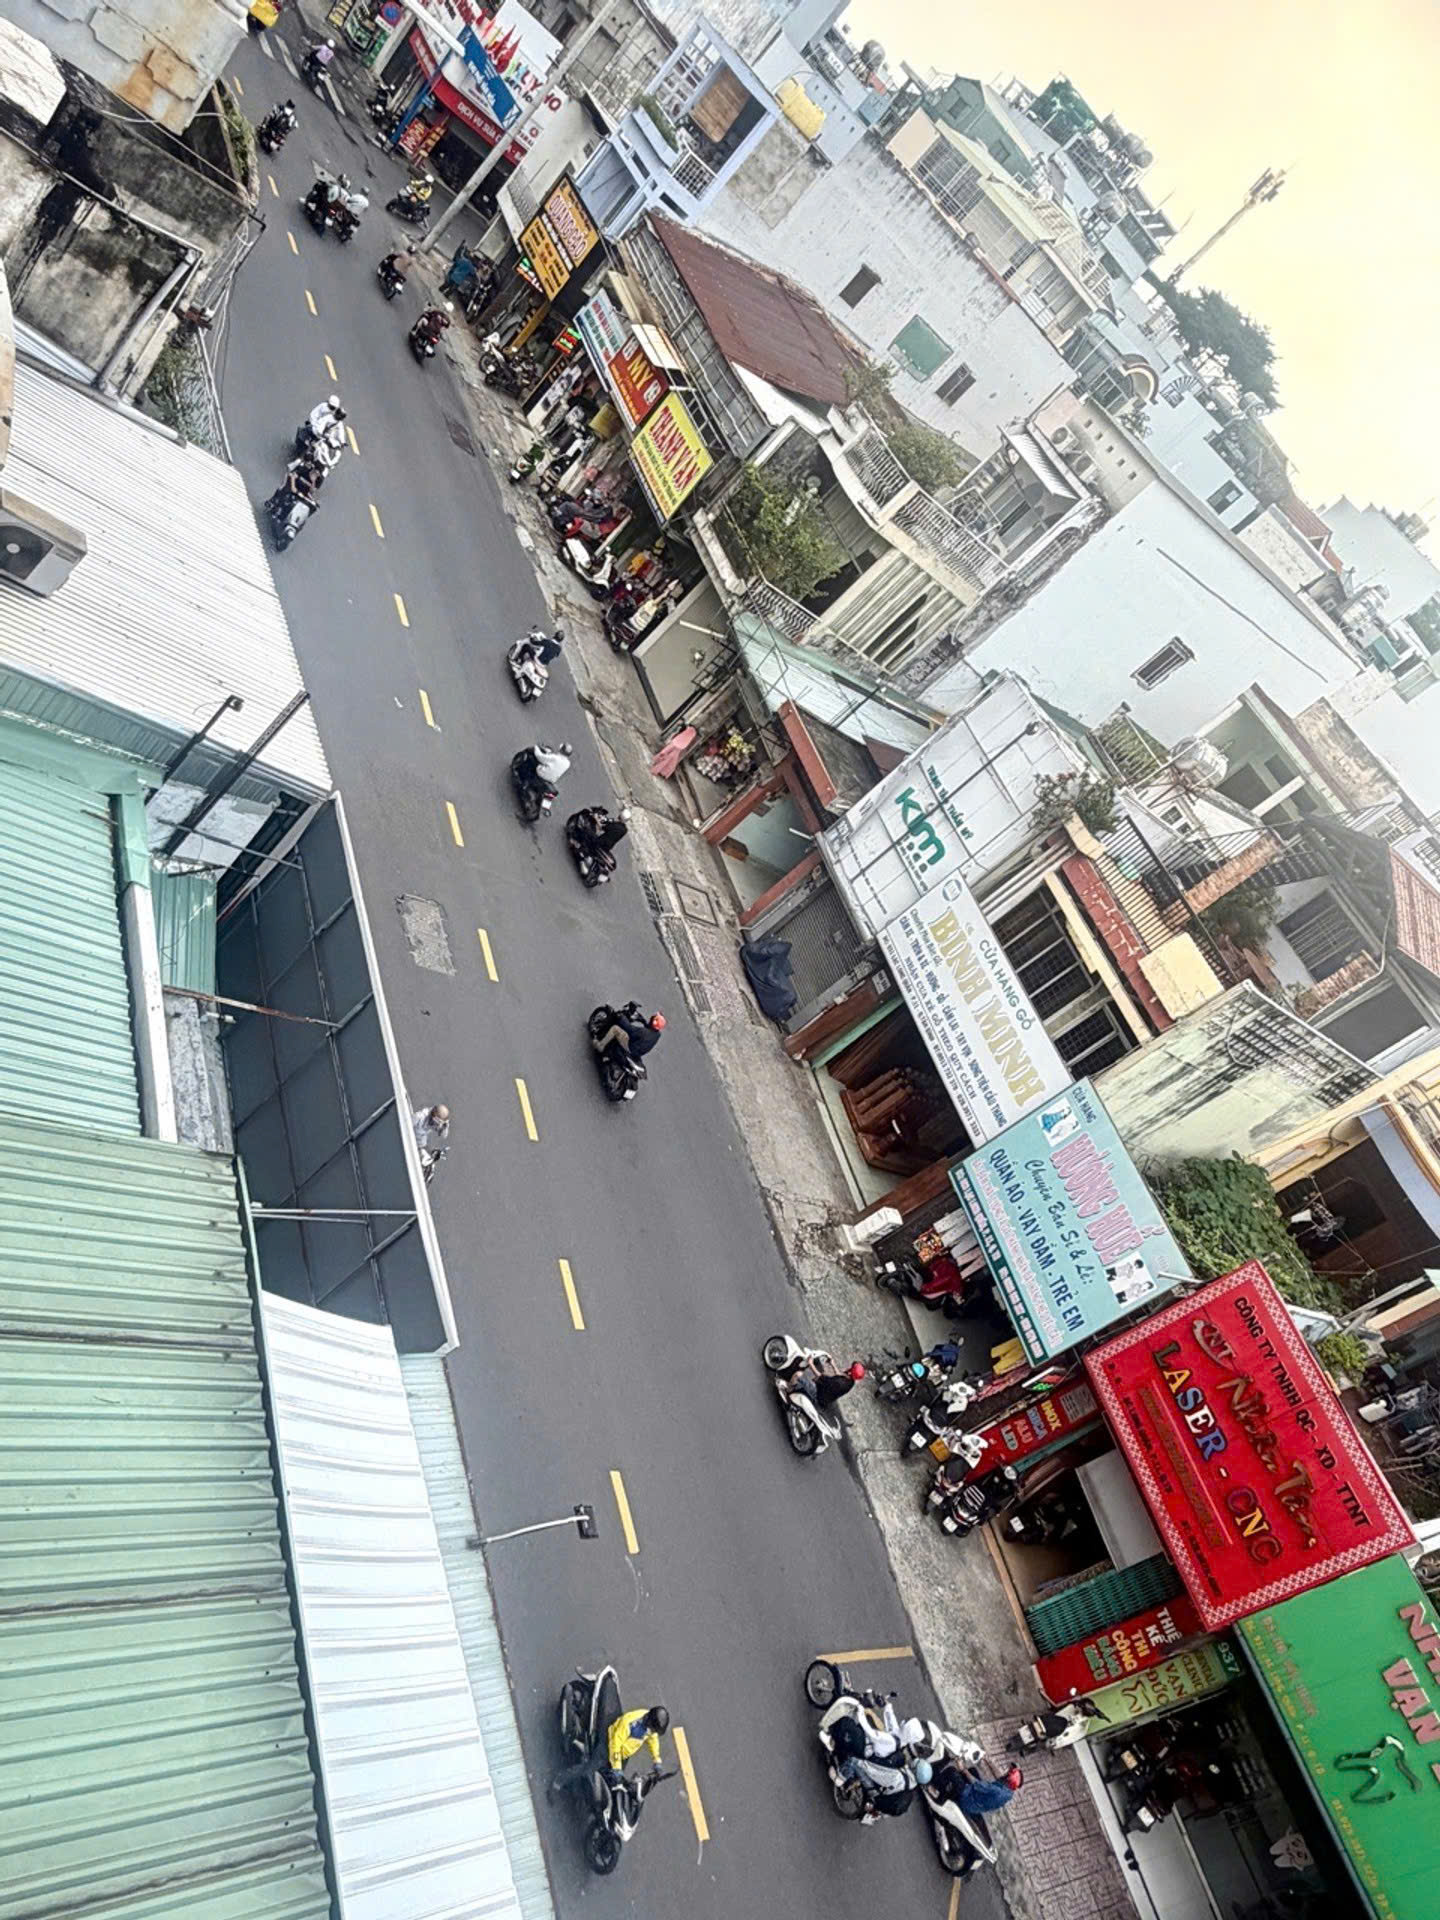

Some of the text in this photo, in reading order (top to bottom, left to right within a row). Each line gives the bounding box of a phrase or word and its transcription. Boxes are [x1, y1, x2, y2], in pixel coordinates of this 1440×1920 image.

[972, 994, 1045, 1107] MINH
[1023, 1159, 1054, 1203] Chuyên
[1068, 1246, 1087, 1261] &
[1019, 1208, 1041, 1236] VÁY
[1030, 1236, 1056, 1270] ĐẦM
[1062, 1306, 1084, 1331] EM
[1152, 1341, 1228, 1461] LASER
[1226, 1486, 1282, 1565] CNC
[1234, 1298, 1265, 1338] CÔNG
[1258, 1338, 1279, 1358] TY
[1272, 1362, 1301, 1406] TNHH
[1337, 1481, 1372, 1526] TTNT
[1112, 1630, 1137, 1671] CÔNG
[1131, 1630, 1150, 1657] THI
[1218, 1643, 1240, 1672] 937
